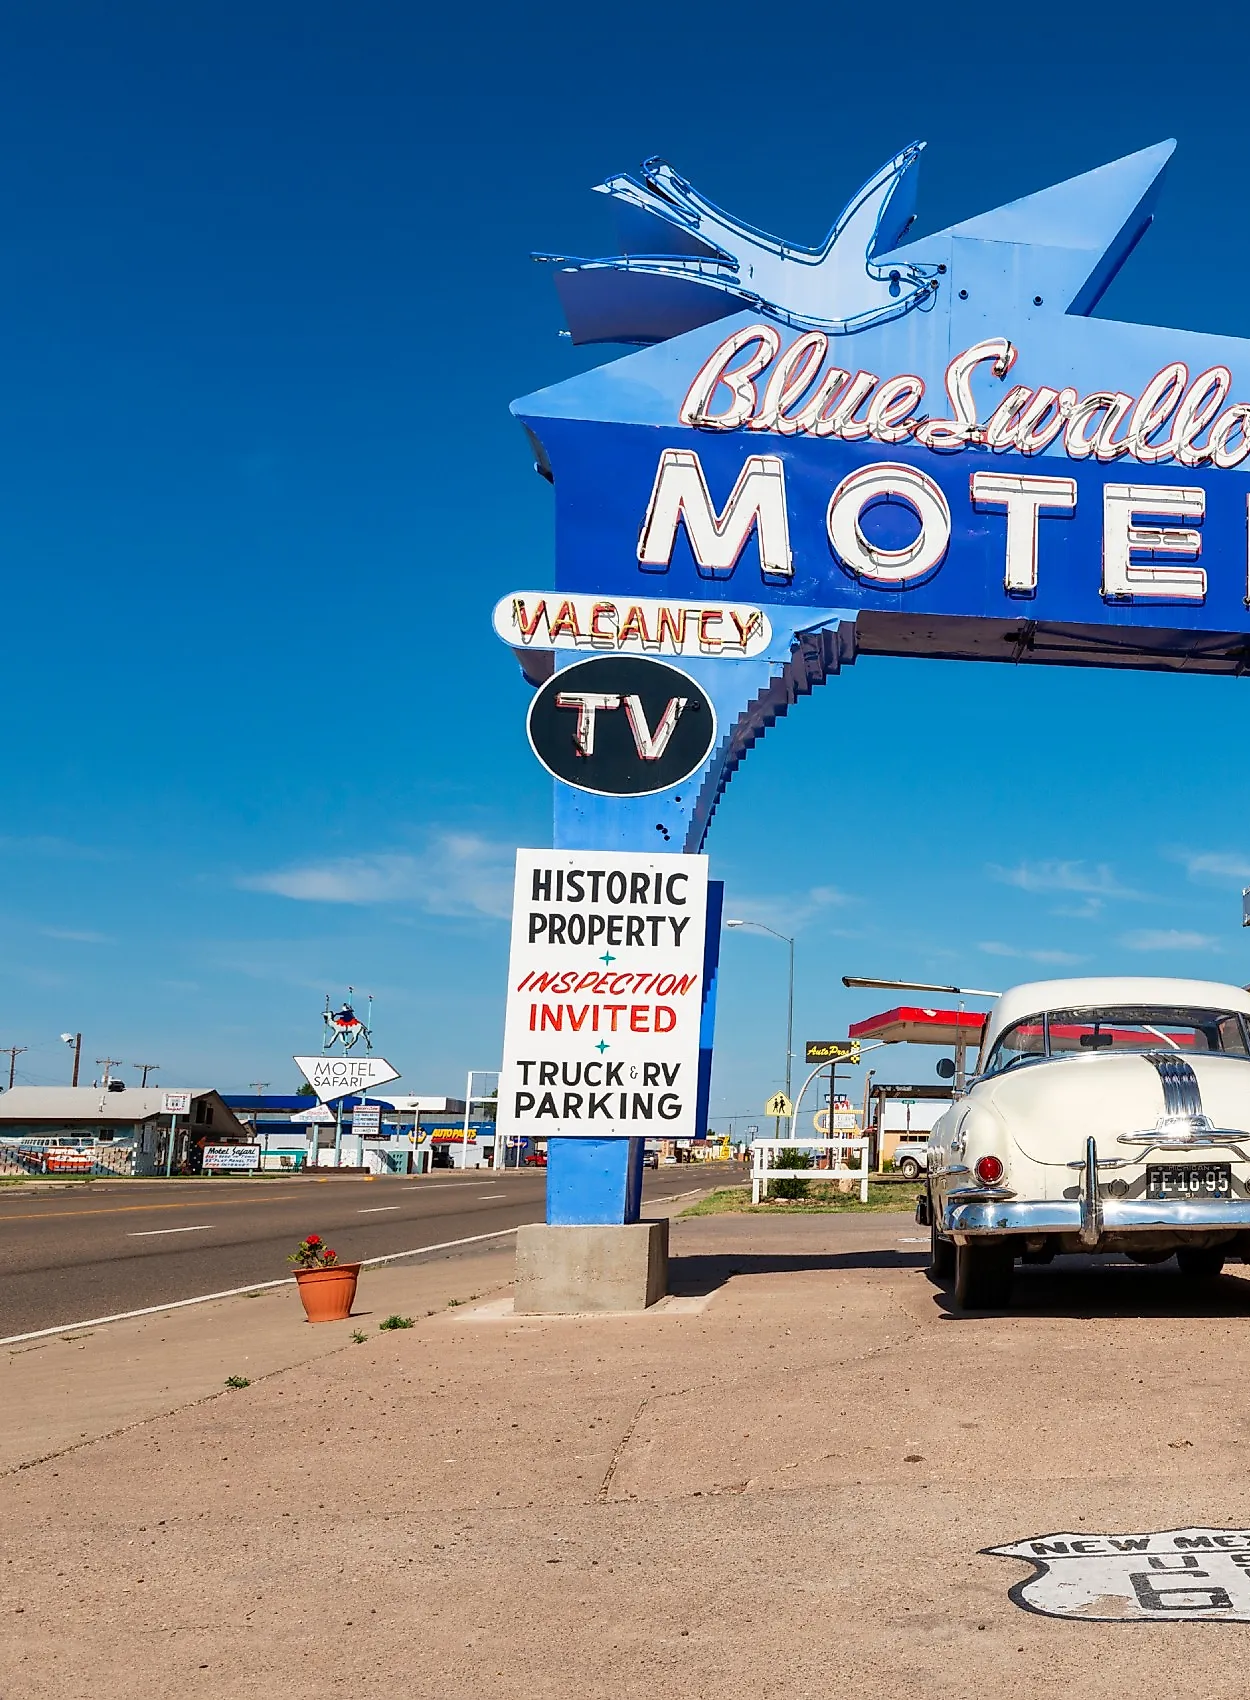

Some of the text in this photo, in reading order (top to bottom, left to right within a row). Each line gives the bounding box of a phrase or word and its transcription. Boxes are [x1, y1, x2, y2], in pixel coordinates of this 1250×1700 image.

[680, 323, 926, 437] Blue
[511, 598, 763, 650] VACANCY
[555, 691, 693, 760] TV
[531, 868, 689, 906] HISTORIC
[528, 912, 691, 948] PROPERTY
[517, 970, 698, 997] INSPECTION
[529, 1003, 678, 1033] INVITED
[806, 1046, 829, 1056] Auto
[314, 1062, 376, 1076] MOTEL
[314, 1077, 362, 1087] SAFARI
[516, 1060, 682, 1087] TRUCK & RV
[514, 1091, 683, 1121] PARKING
[432, 1128, 454, 1138] AUTO
[207, 1146, 256, 1156] Motel Safari
[1030, 1540, 1150, 1555] NEW
